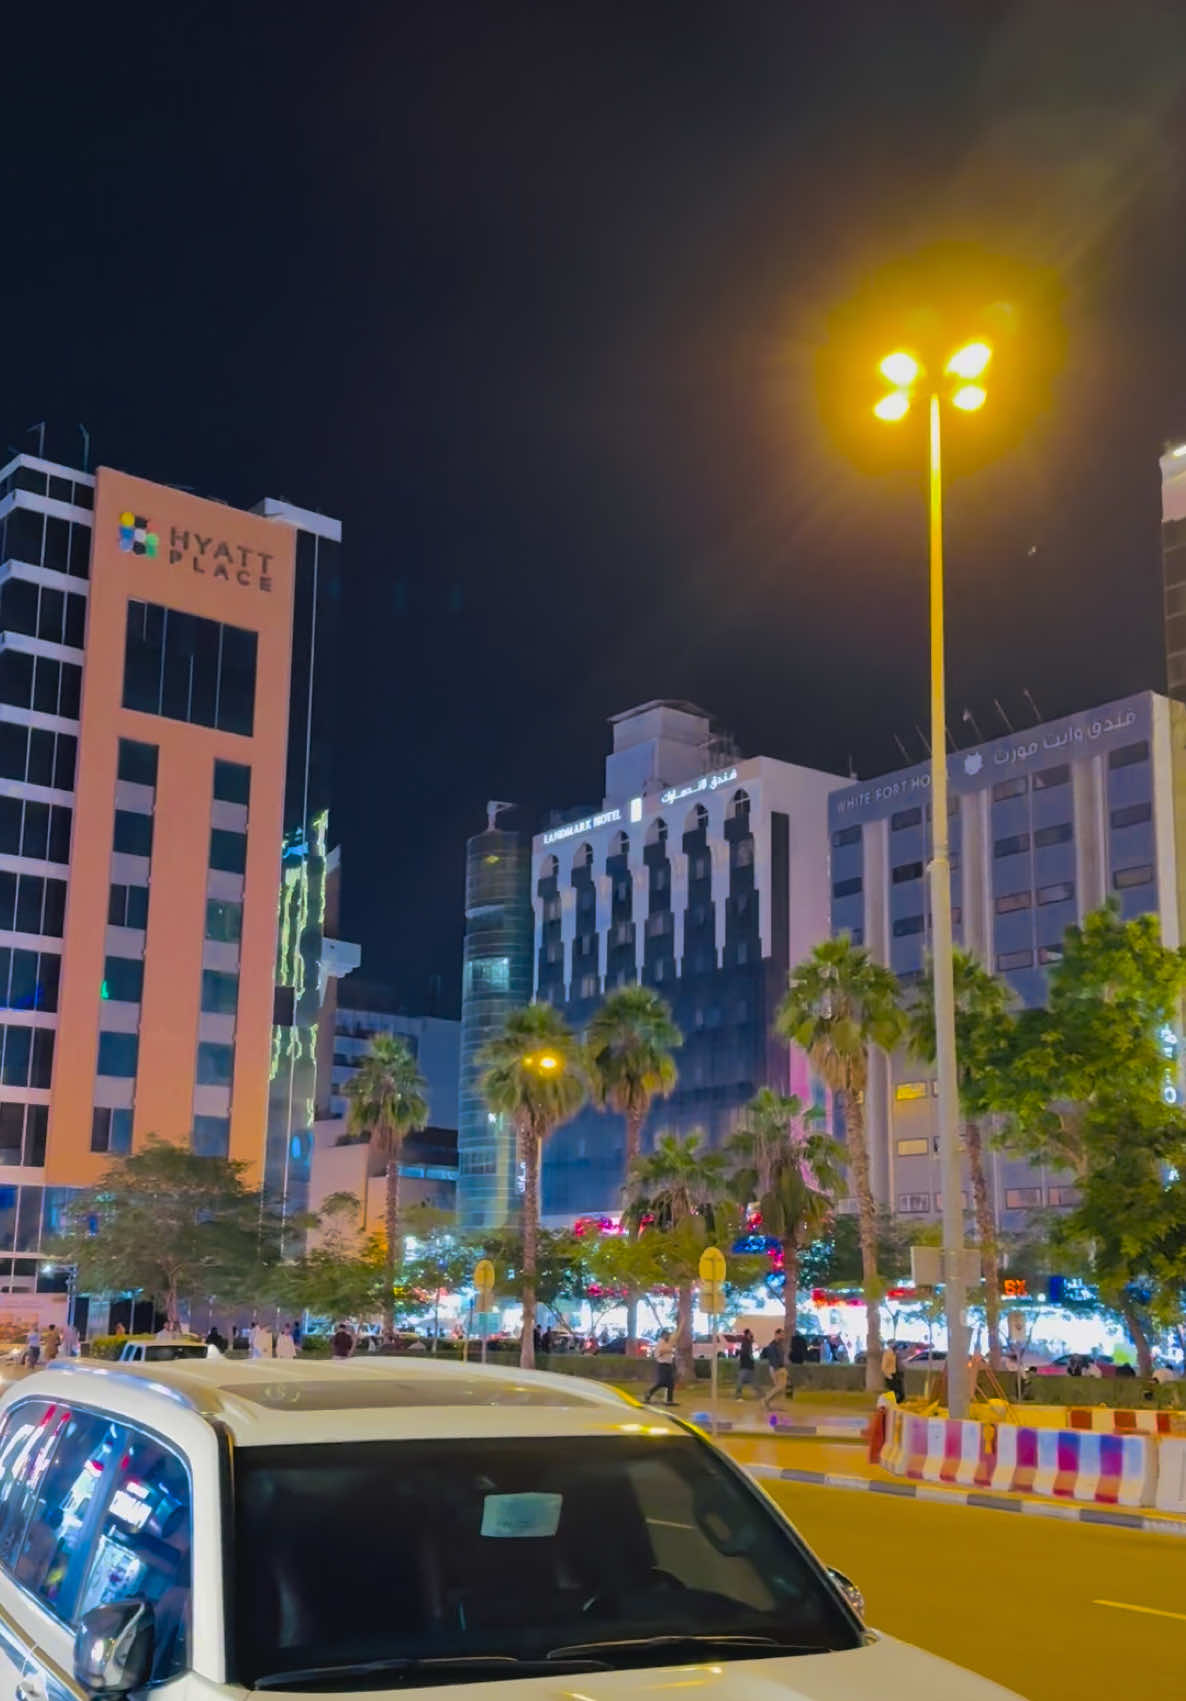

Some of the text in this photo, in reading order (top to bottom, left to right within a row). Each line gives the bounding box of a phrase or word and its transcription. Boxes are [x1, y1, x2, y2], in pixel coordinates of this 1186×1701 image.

[170, 526, 273, 574] HYATT
[169, 550, 272, 592] PLACE
[838, 792, 871, 813] WHITE
[875, 781, 906, 800] FORT
[543, 808, 621, 845] LANDMARK HOTEL
